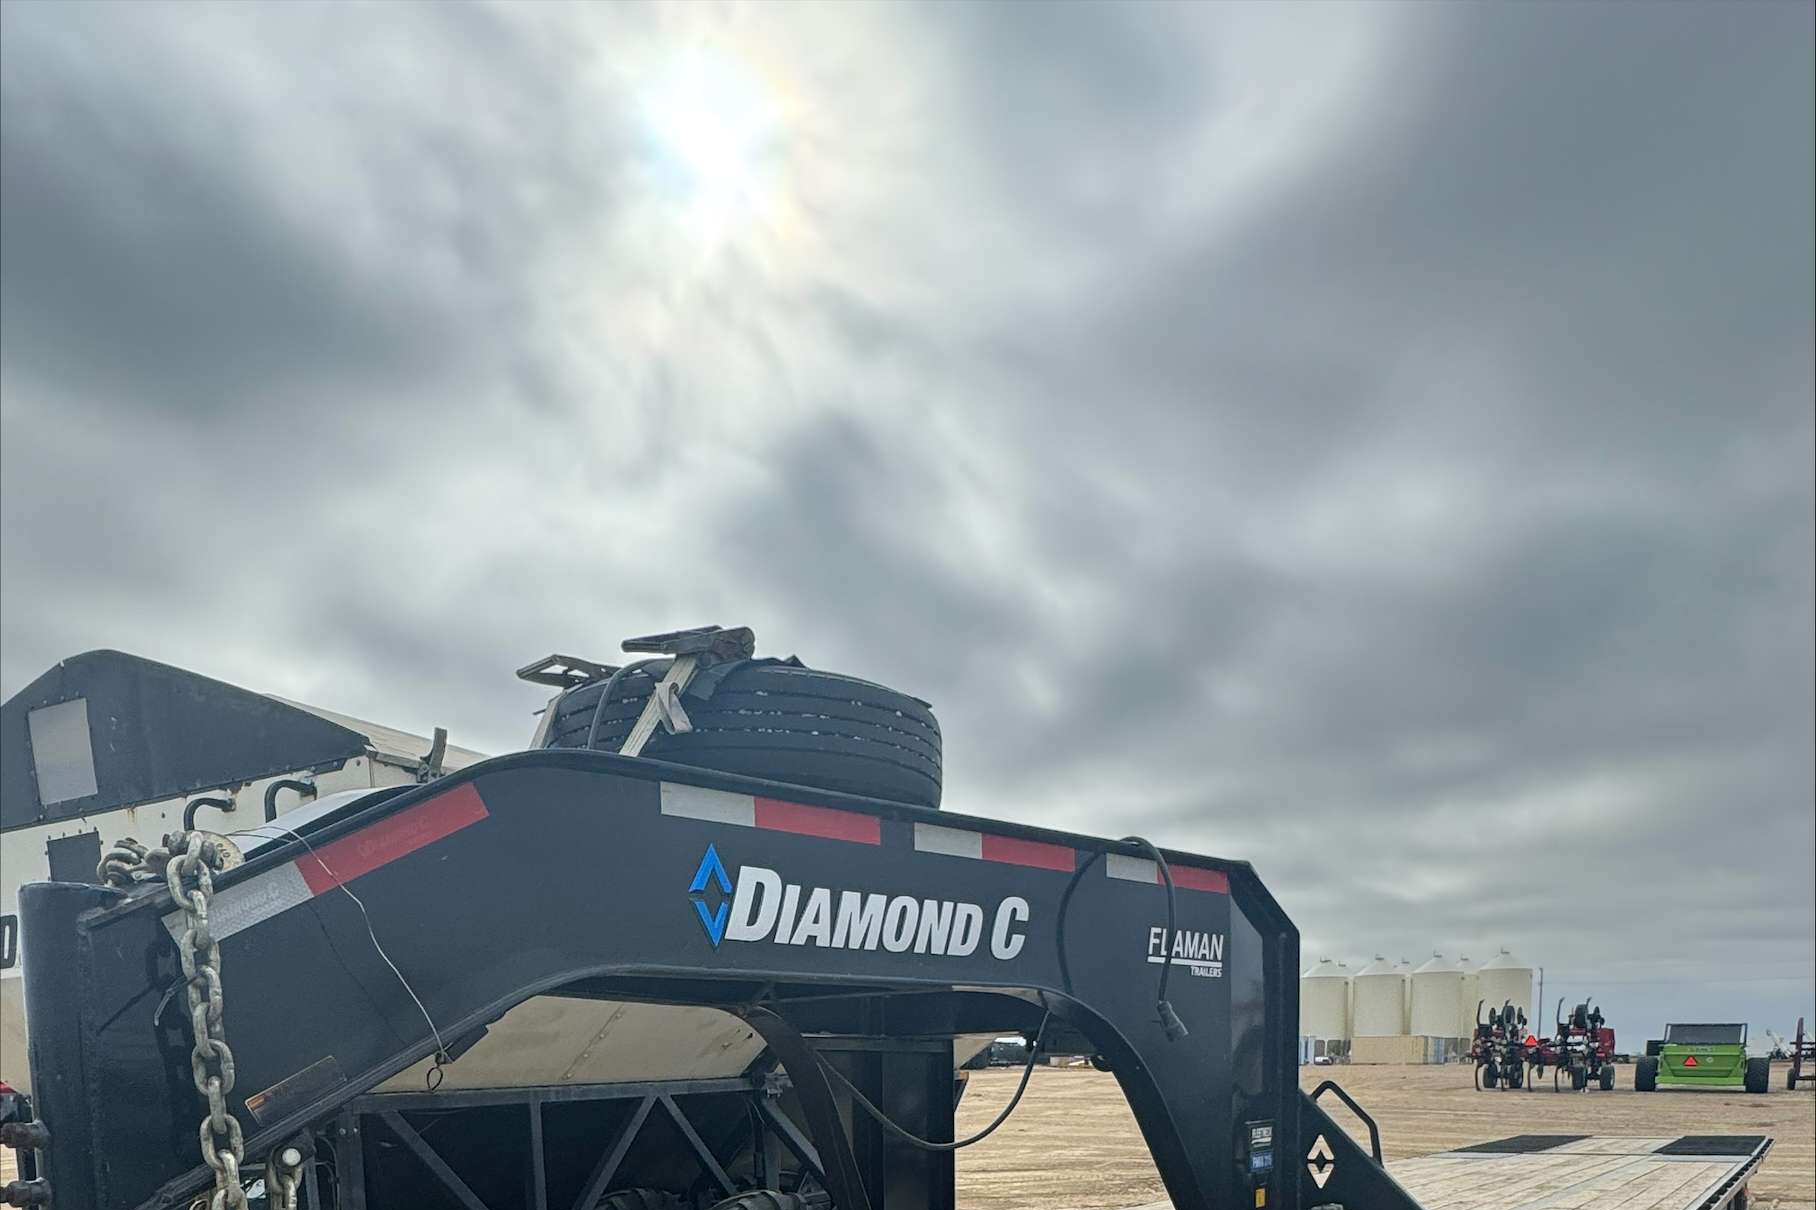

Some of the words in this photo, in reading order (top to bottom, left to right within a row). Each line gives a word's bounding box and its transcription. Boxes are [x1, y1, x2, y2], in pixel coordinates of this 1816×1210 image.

[724, 865, 984, 957] DIAMOND
[990, 896, 1030, 961] C
[1148, 927, 1224, 961] FLAMAN
[1190, 965, 1223, 978] TRAILERS
